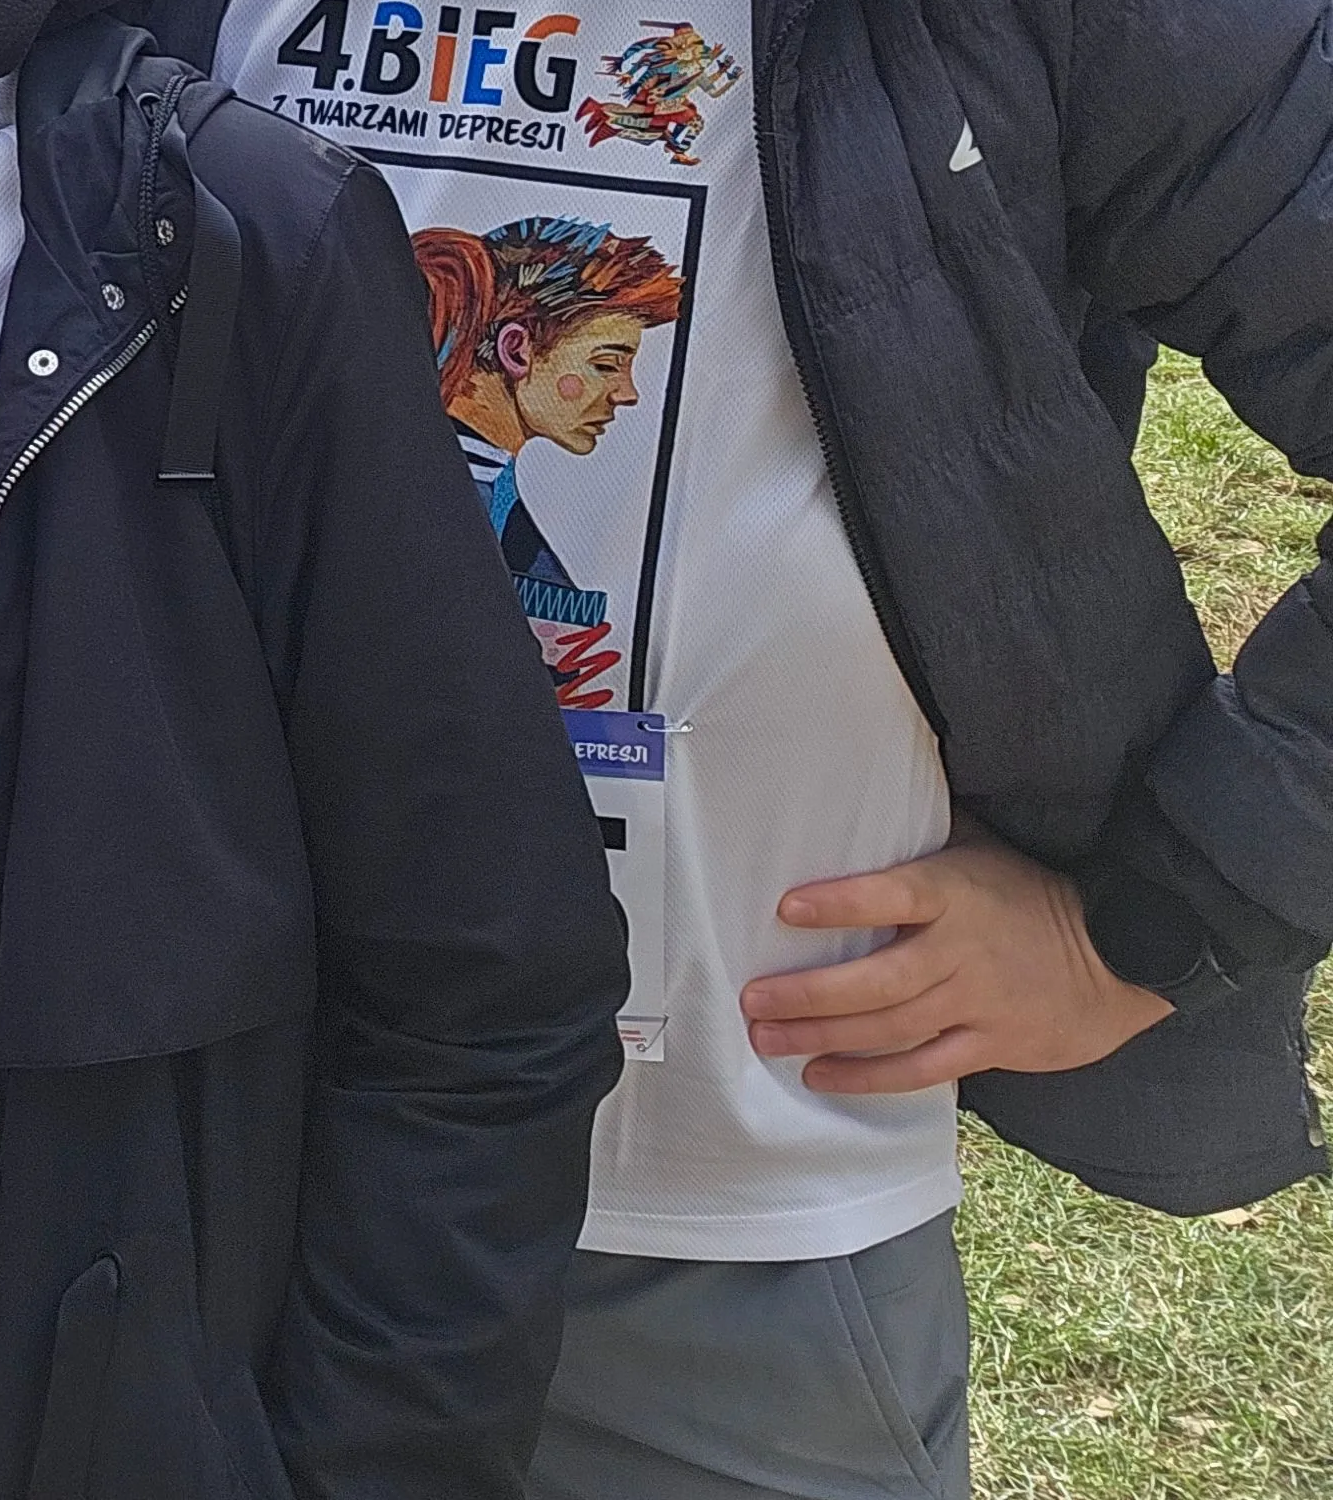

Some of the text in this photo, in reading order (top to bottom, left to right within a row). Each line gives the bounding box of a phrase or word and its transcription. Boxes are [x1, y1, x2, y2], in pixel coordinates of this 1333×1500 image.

[295, 98, 428, 138] TWARZAMI
[438, 113, 566, 152] DEPRESJI
[573, 742, 648, 764] EPRESJI
